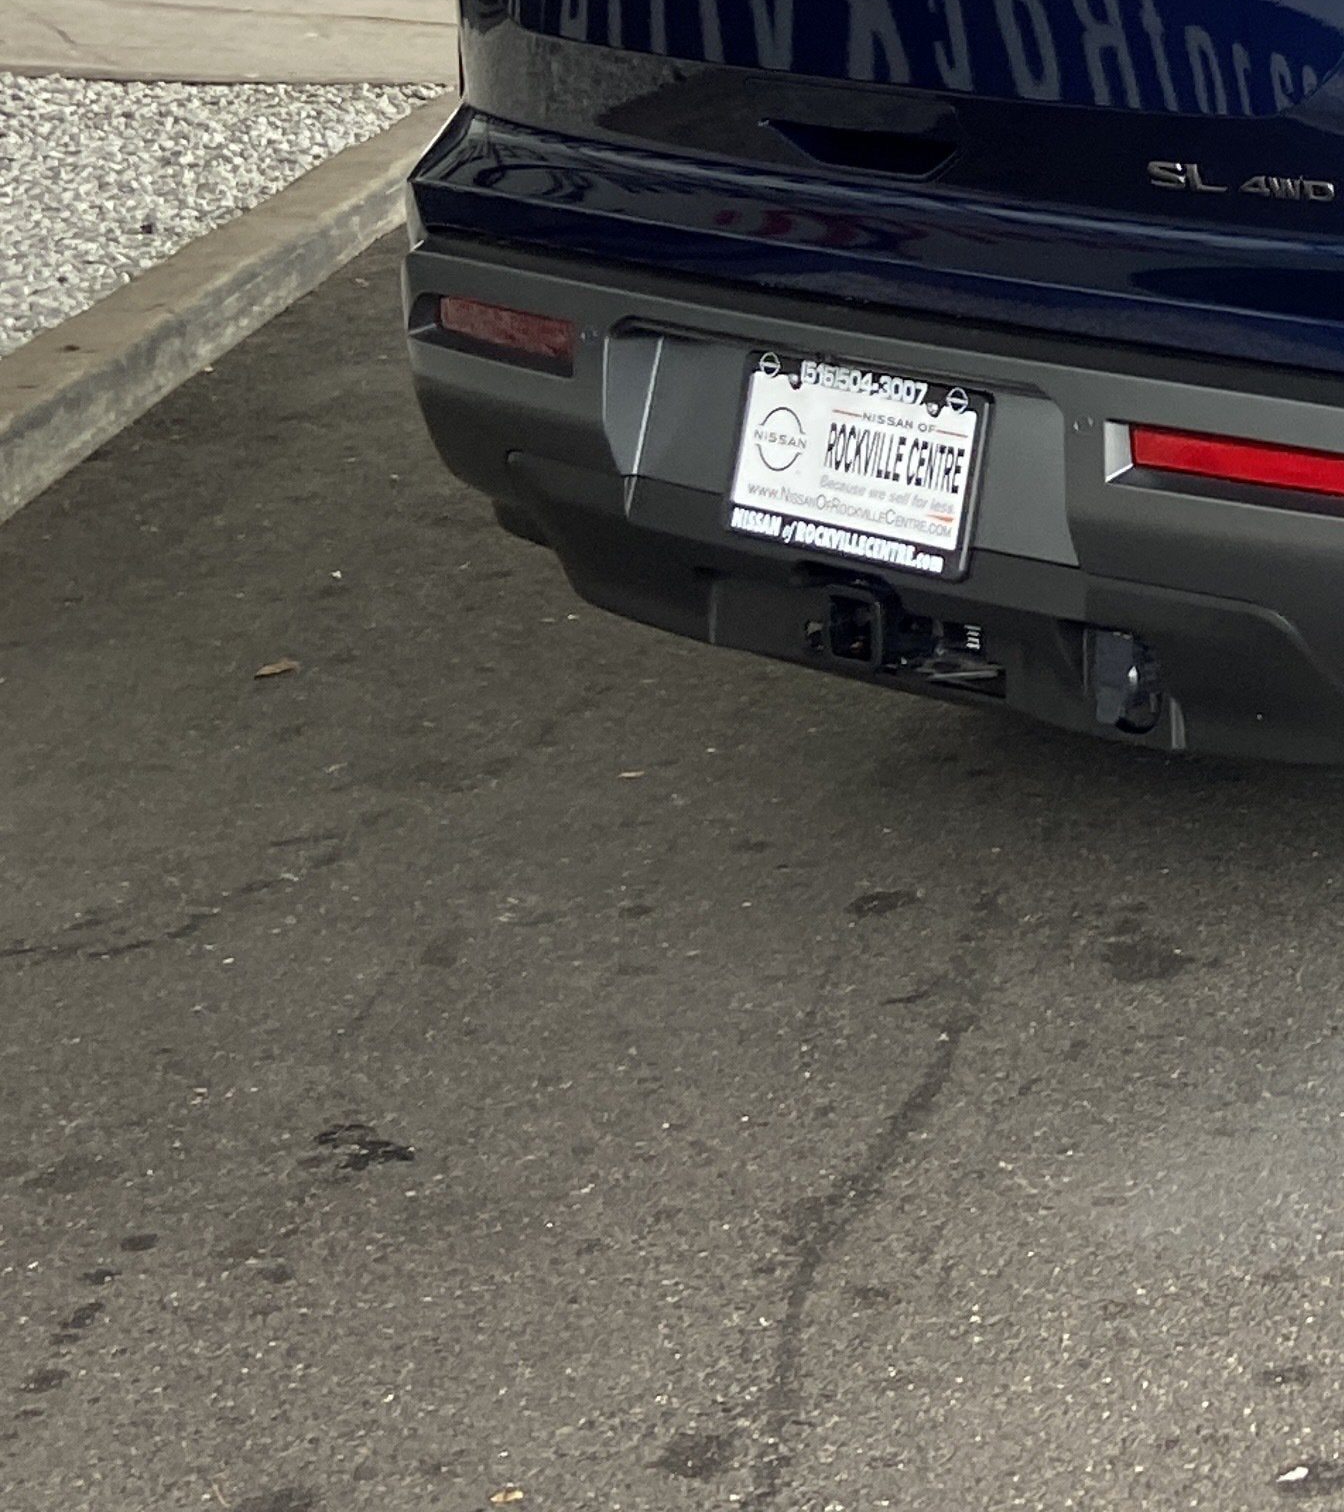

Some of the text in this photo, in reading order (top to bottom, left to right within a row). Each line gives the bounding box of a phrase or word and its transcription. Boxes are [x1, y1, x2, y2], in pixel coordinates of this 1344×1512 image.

[1147, 161, 1335, 202] SL 4WD
[862, 411, 936, 434] NISSAN OF
[754, 428, 808, 450] NISSAN
[824, 422, 966, 495] ROCKVILLE CENTRE
[820, 474, 866, 497] Because
[731, 506, 783, 538] NISSAN
[781, 520, 799, 544] of
